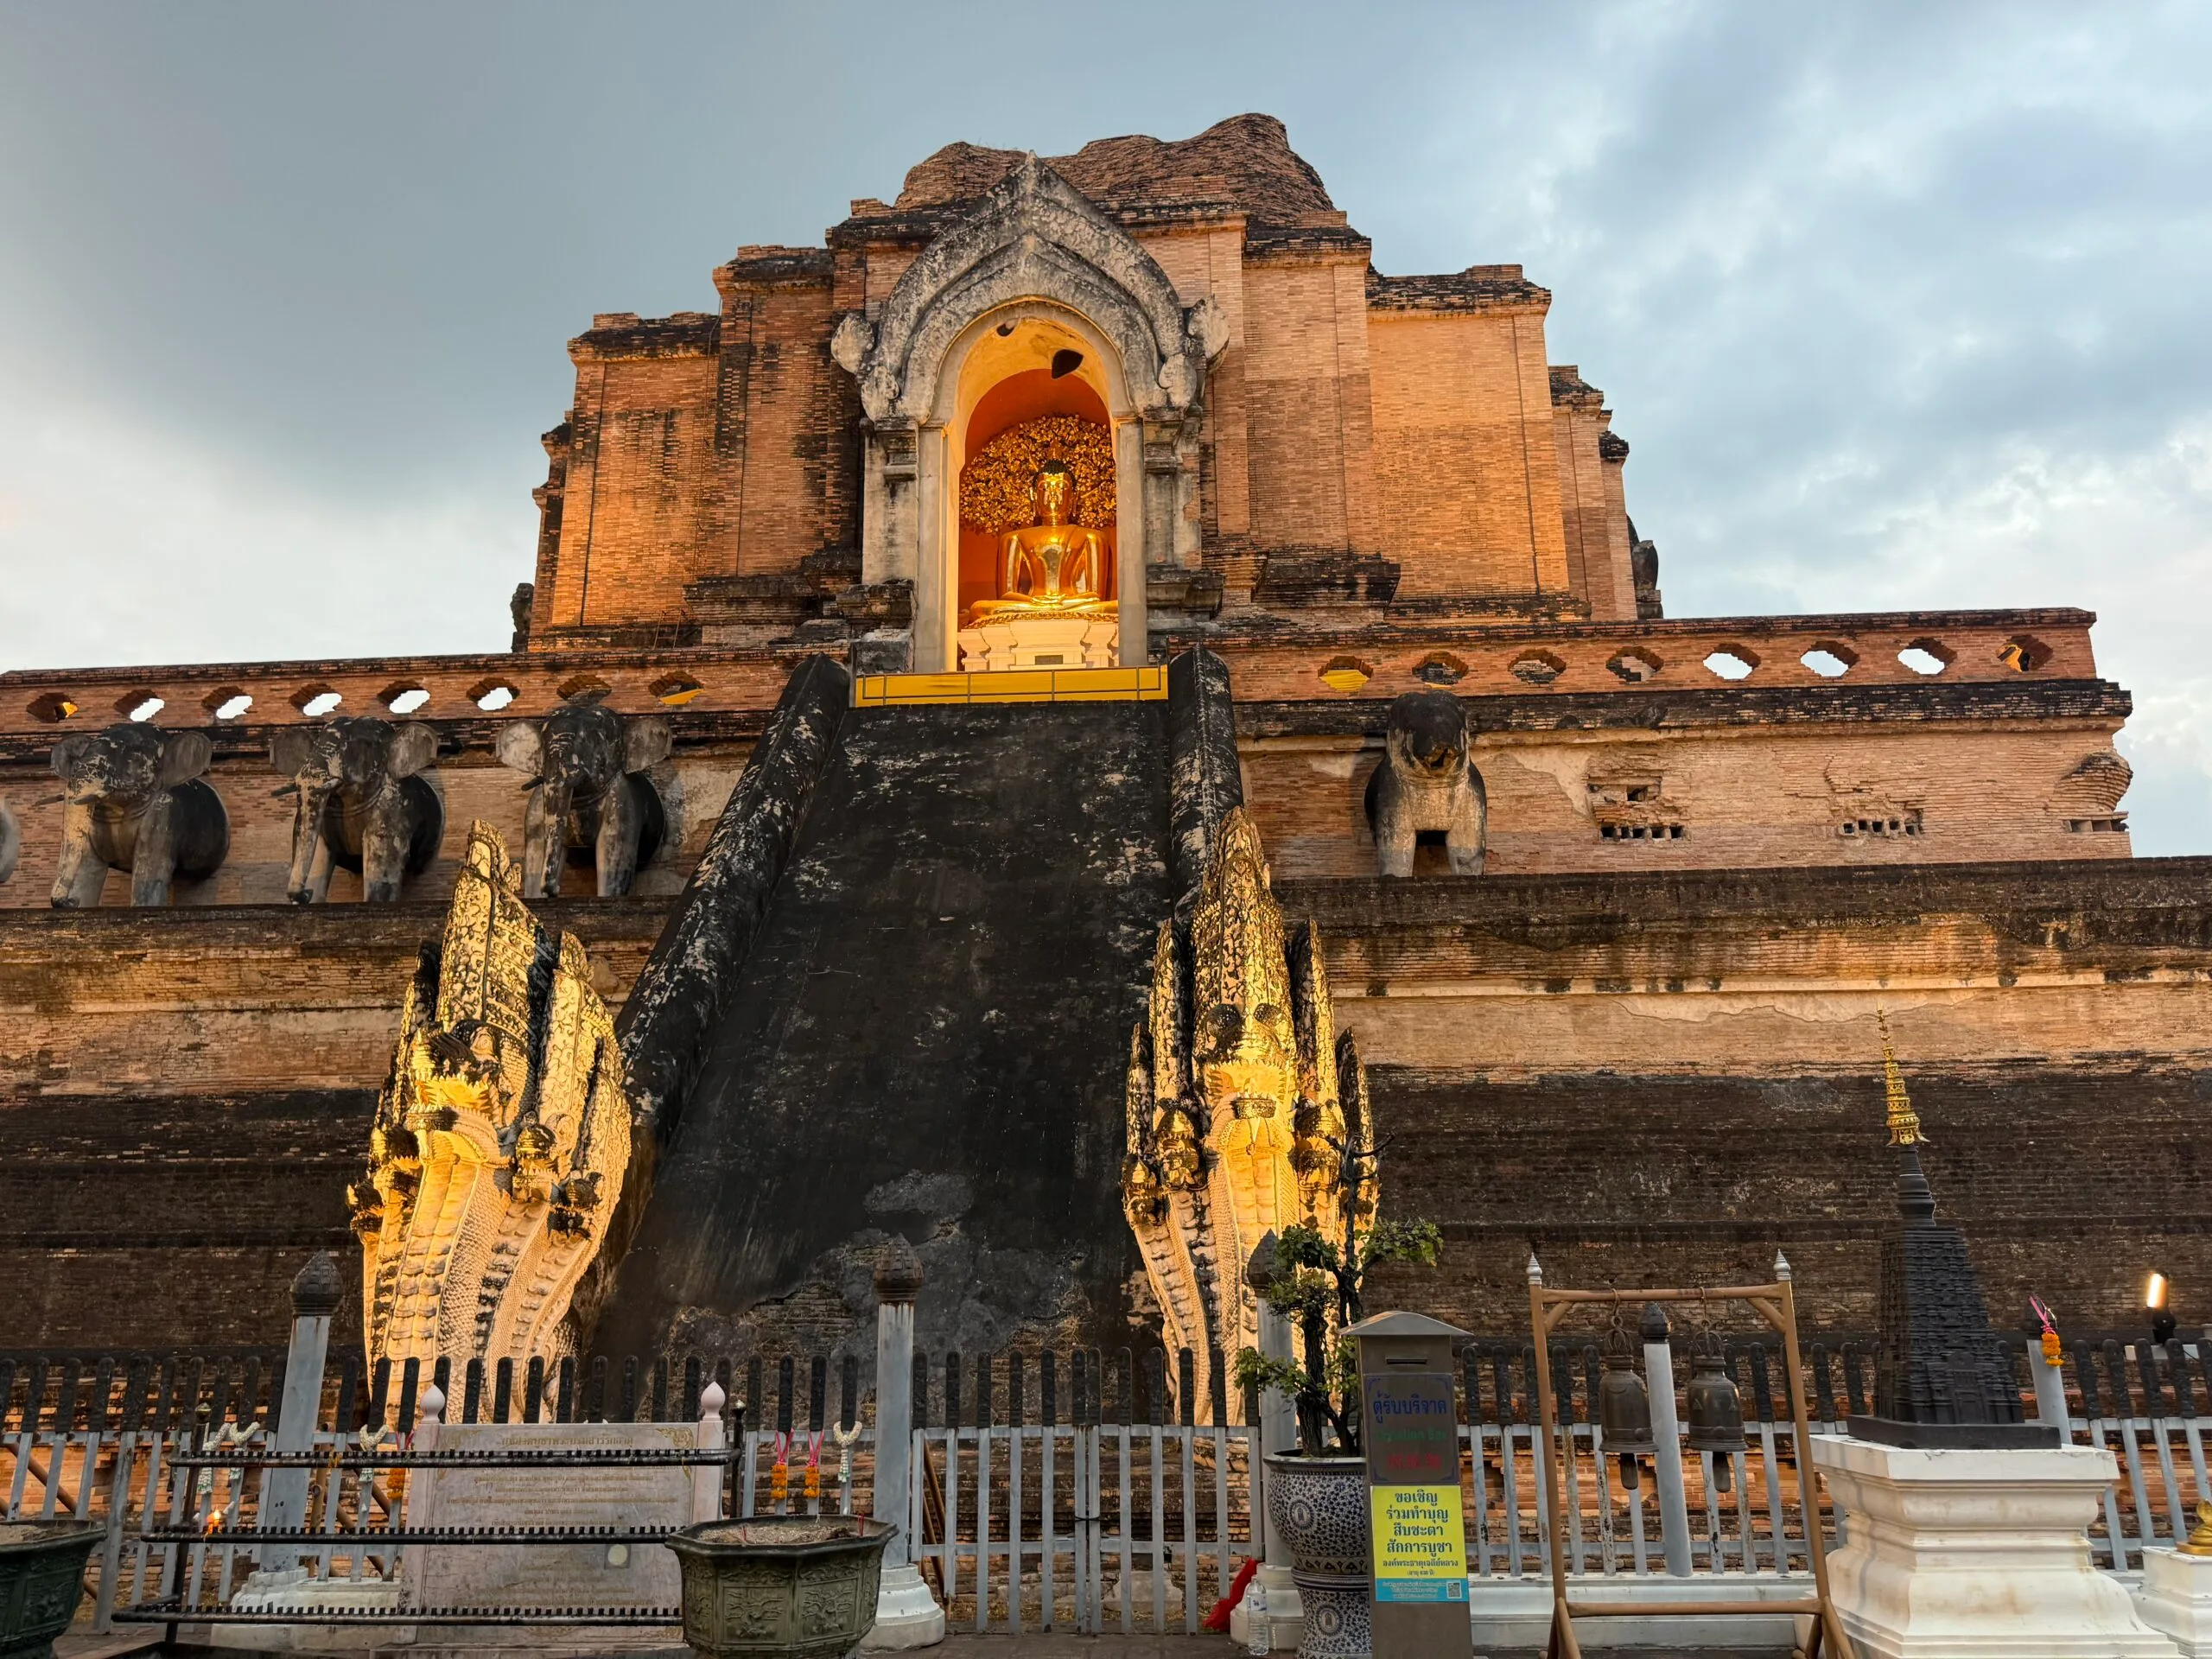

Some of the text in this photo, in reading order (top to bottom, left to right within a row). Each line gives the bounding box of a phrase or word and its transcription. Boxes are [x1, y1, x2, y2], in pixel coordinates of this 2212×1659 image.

[1373, 1390, 1447, 1423] ตู้รับบริจาค
[1395, 1489, 1438, 1506] ขอเชิญ
[1386, 1505, 1448, 1523] ร่วมทำบุญ
[1386, 1539, 1452, 1557] สักการบูชา
